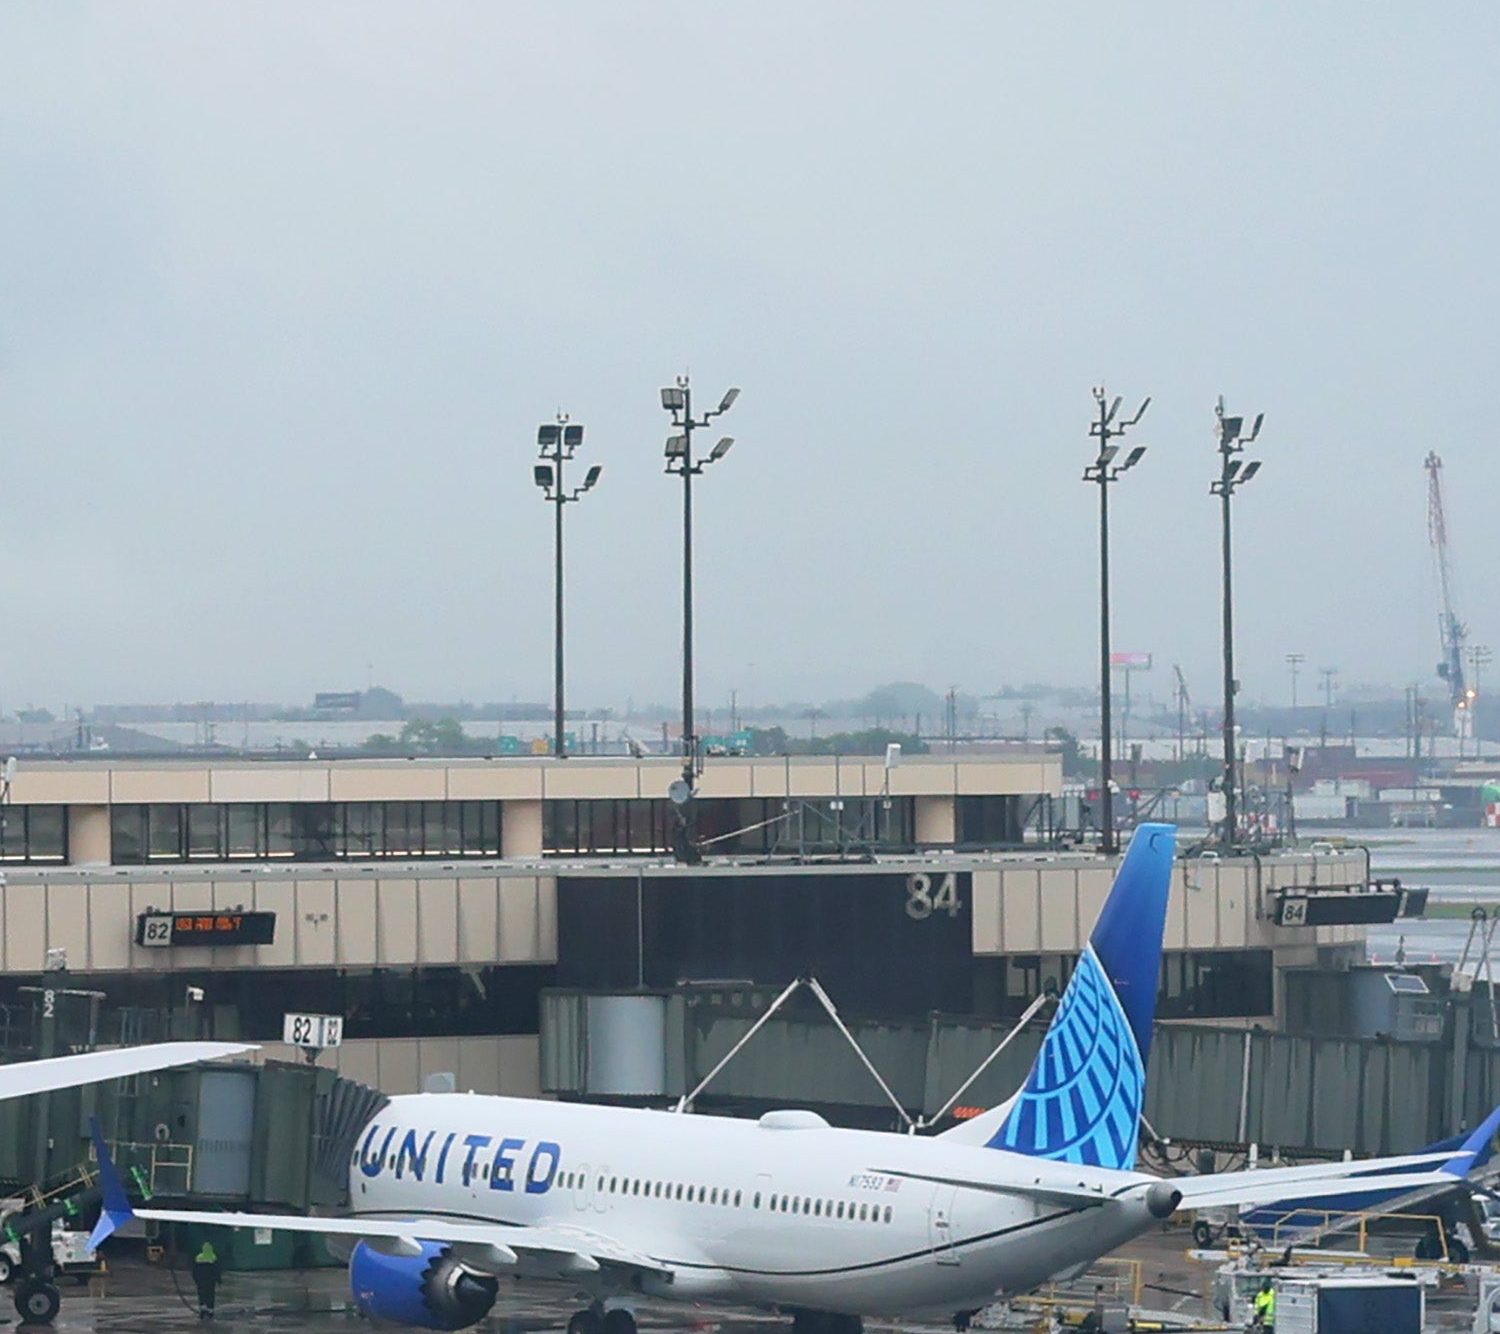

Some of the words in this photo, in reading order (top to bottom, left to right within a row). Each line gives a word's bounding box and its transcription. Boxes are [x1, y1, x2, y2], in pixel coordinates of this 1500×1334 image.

[905, 873, 963, 921] 84
[1283, 903, 1305, 923] 84
[147, 922, 169, 941] 82
[43, 990, 55, 1018] 82
[293, 1017, 312, 1044] 82
[360, 1124, 562, 1195] UNITED
